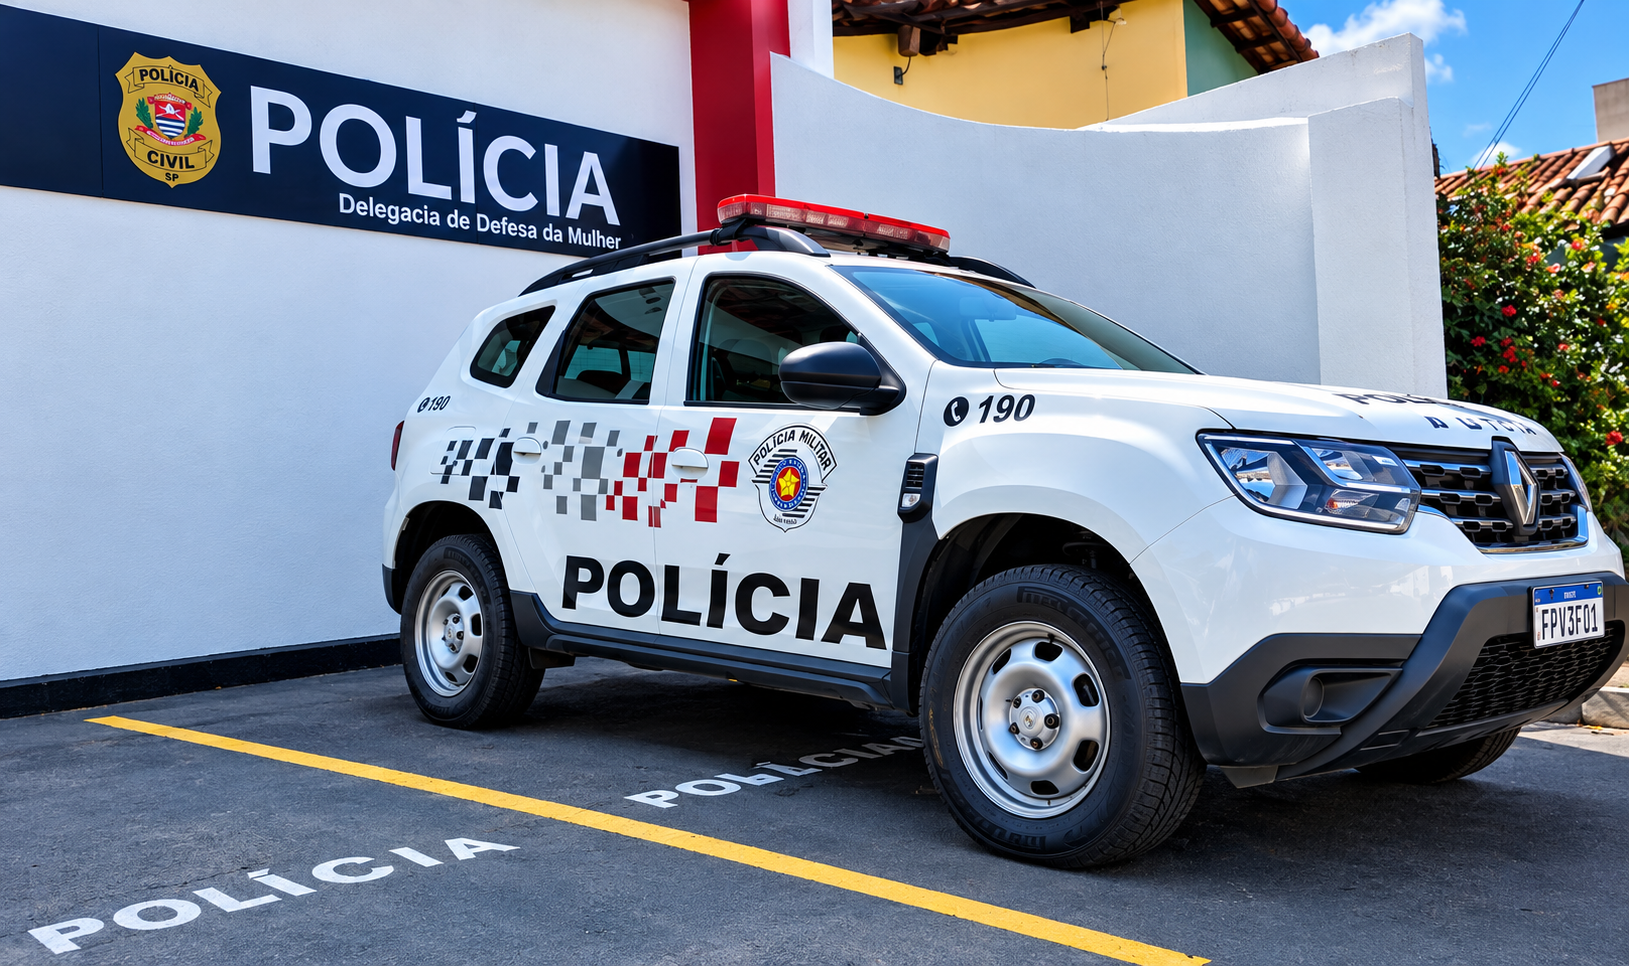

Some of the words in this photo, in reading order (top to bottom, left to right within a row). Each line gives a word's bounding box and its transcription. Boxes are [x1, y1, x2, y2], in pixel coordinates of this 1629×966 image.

[147, 150, 195, 169] CIVIL
[250, 85, 621, 226] POLÍCIA
[165, 172, 179, 182] SP
[339, 193, 441, 226] Delegacia
[447, 209, 470, 230] de
[476, 213, 537, 240] Defesa
[542, 223, 563, 243] da
[568, 226, 622, 250] Mulher
[427, 395, 451, 411] 190
[978, 394, 1036, 424] 190
[798, 430, 832, 471] MILITAR
[562, 552, 888, 651] POLÍCIA
[1541, 603, 1598, 640] FPV3F01
[27, 837, 521, 955] POLÍCIA
